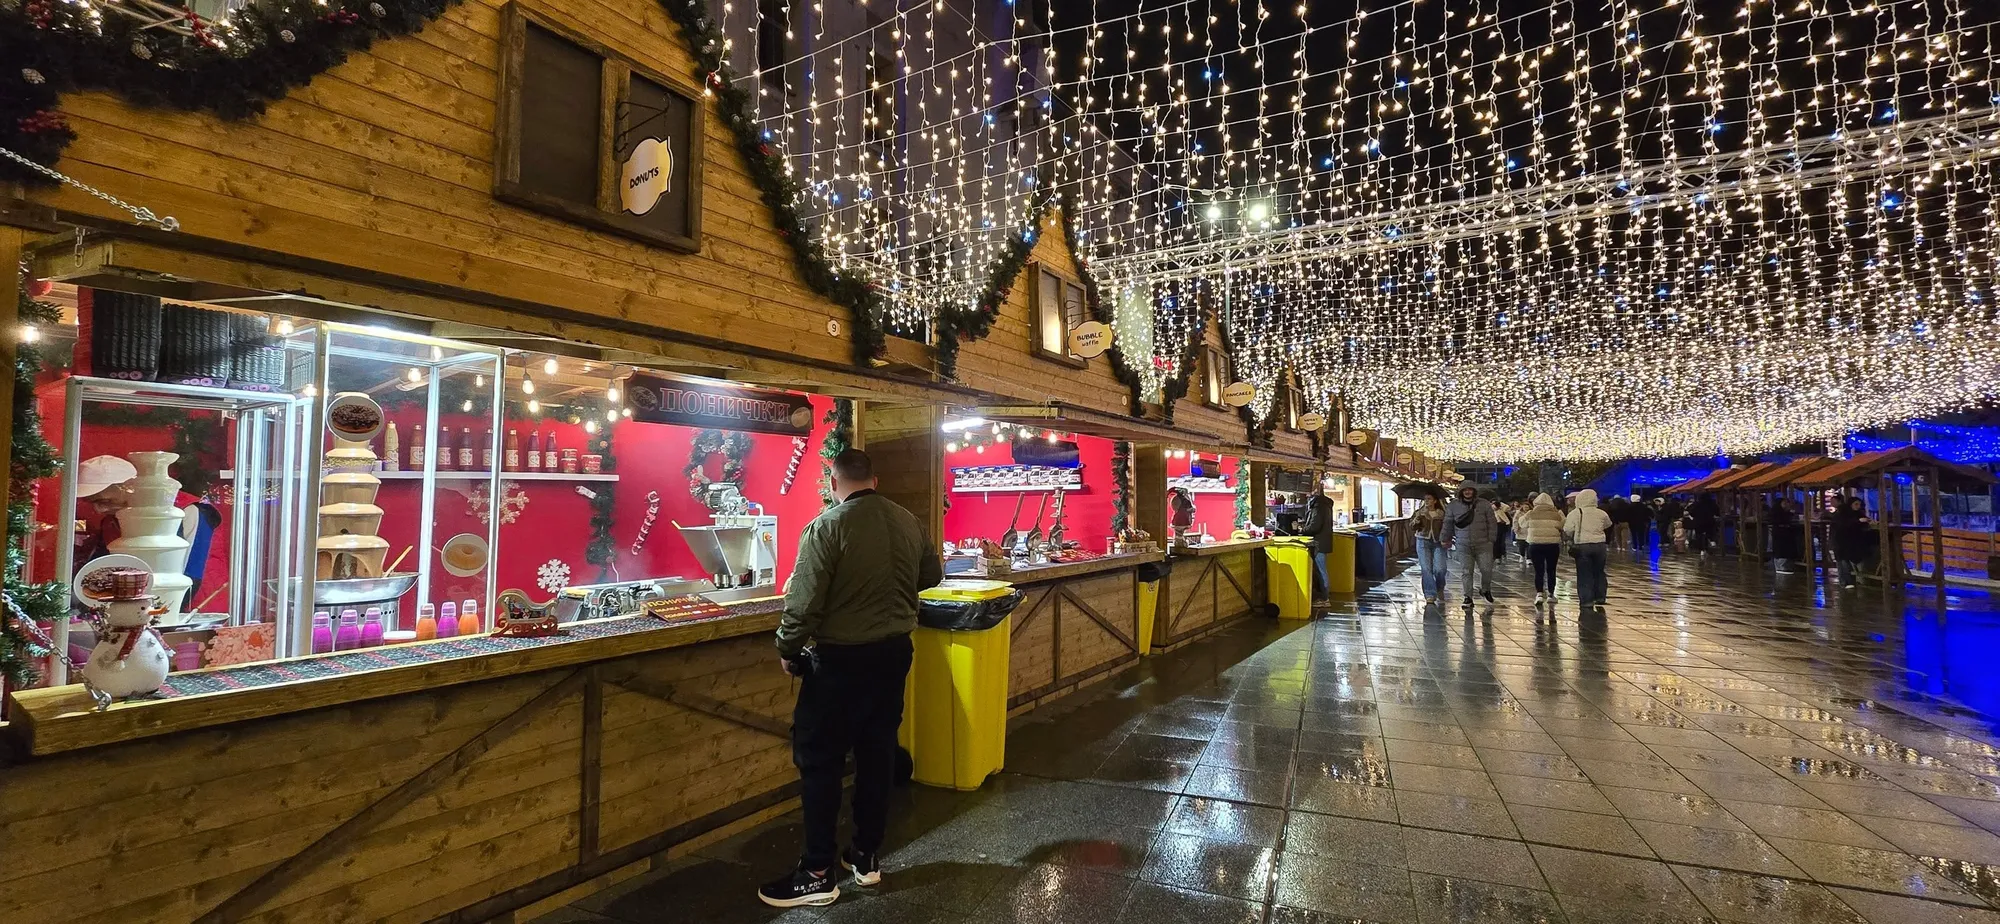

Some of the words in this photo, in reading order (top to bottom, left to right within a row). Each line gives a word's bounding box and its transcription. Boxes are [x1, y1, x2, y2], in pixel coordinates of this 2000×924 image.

[629, 166, 659, 189] DONUTS
[1076, 331, 1103, 341] BUBBLE
[1226, 390, 1252, 398] PANCAKES
[659, 387, 790, 424] ПОНИЧКИ
[809, 878, 827, 888] POLO
